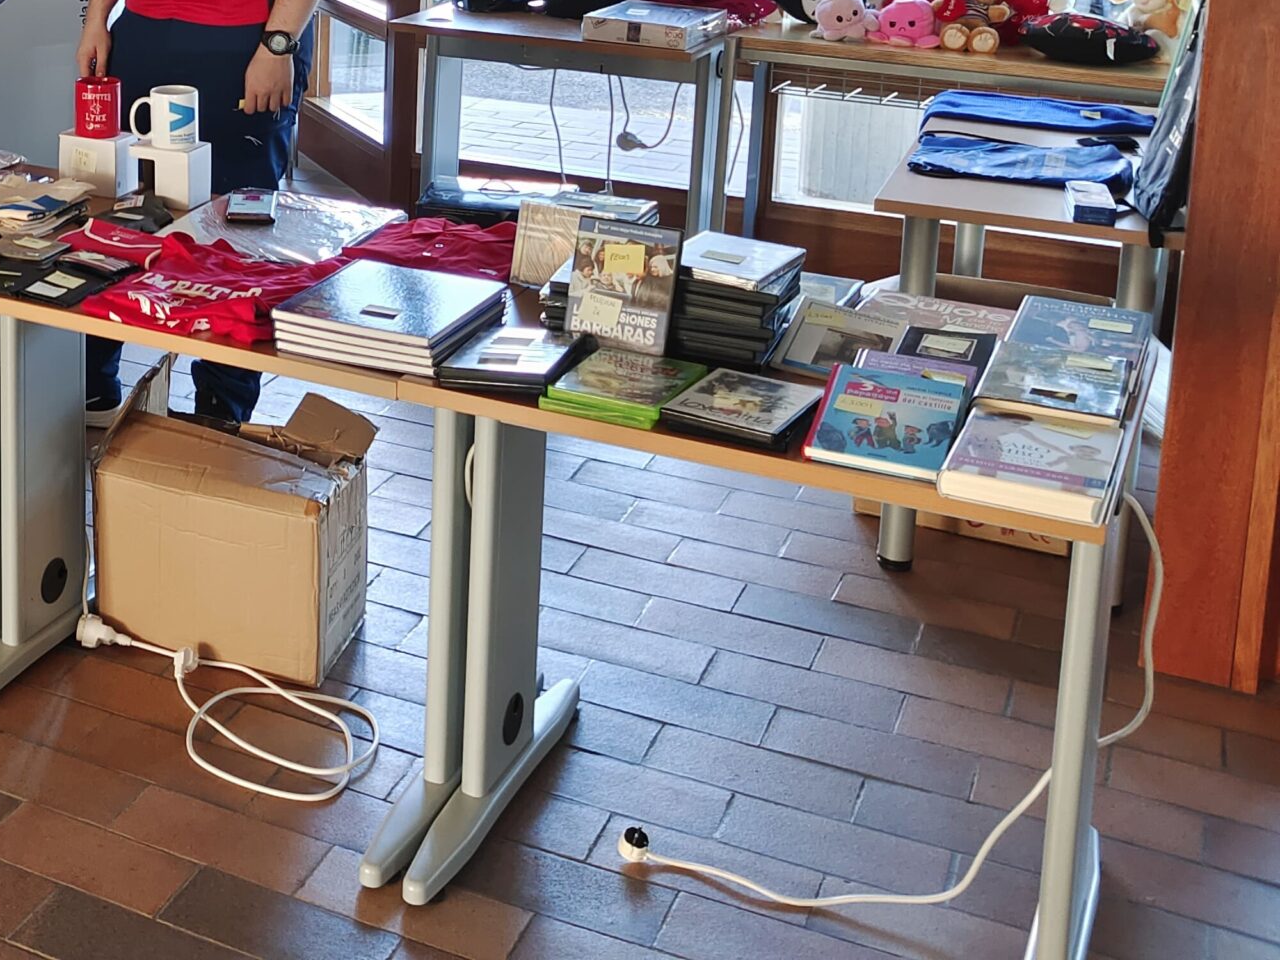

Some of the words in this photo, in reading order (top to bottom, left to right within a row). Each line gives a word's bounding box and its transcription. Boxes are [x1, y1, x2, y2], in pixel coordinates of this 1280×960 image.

[86, 113, 107, 121] LYNX
[879, 292, 1011, 322] Quijote
[619, 313, 657, 328] SIONES
[918, 400, 952, 410] castillo
